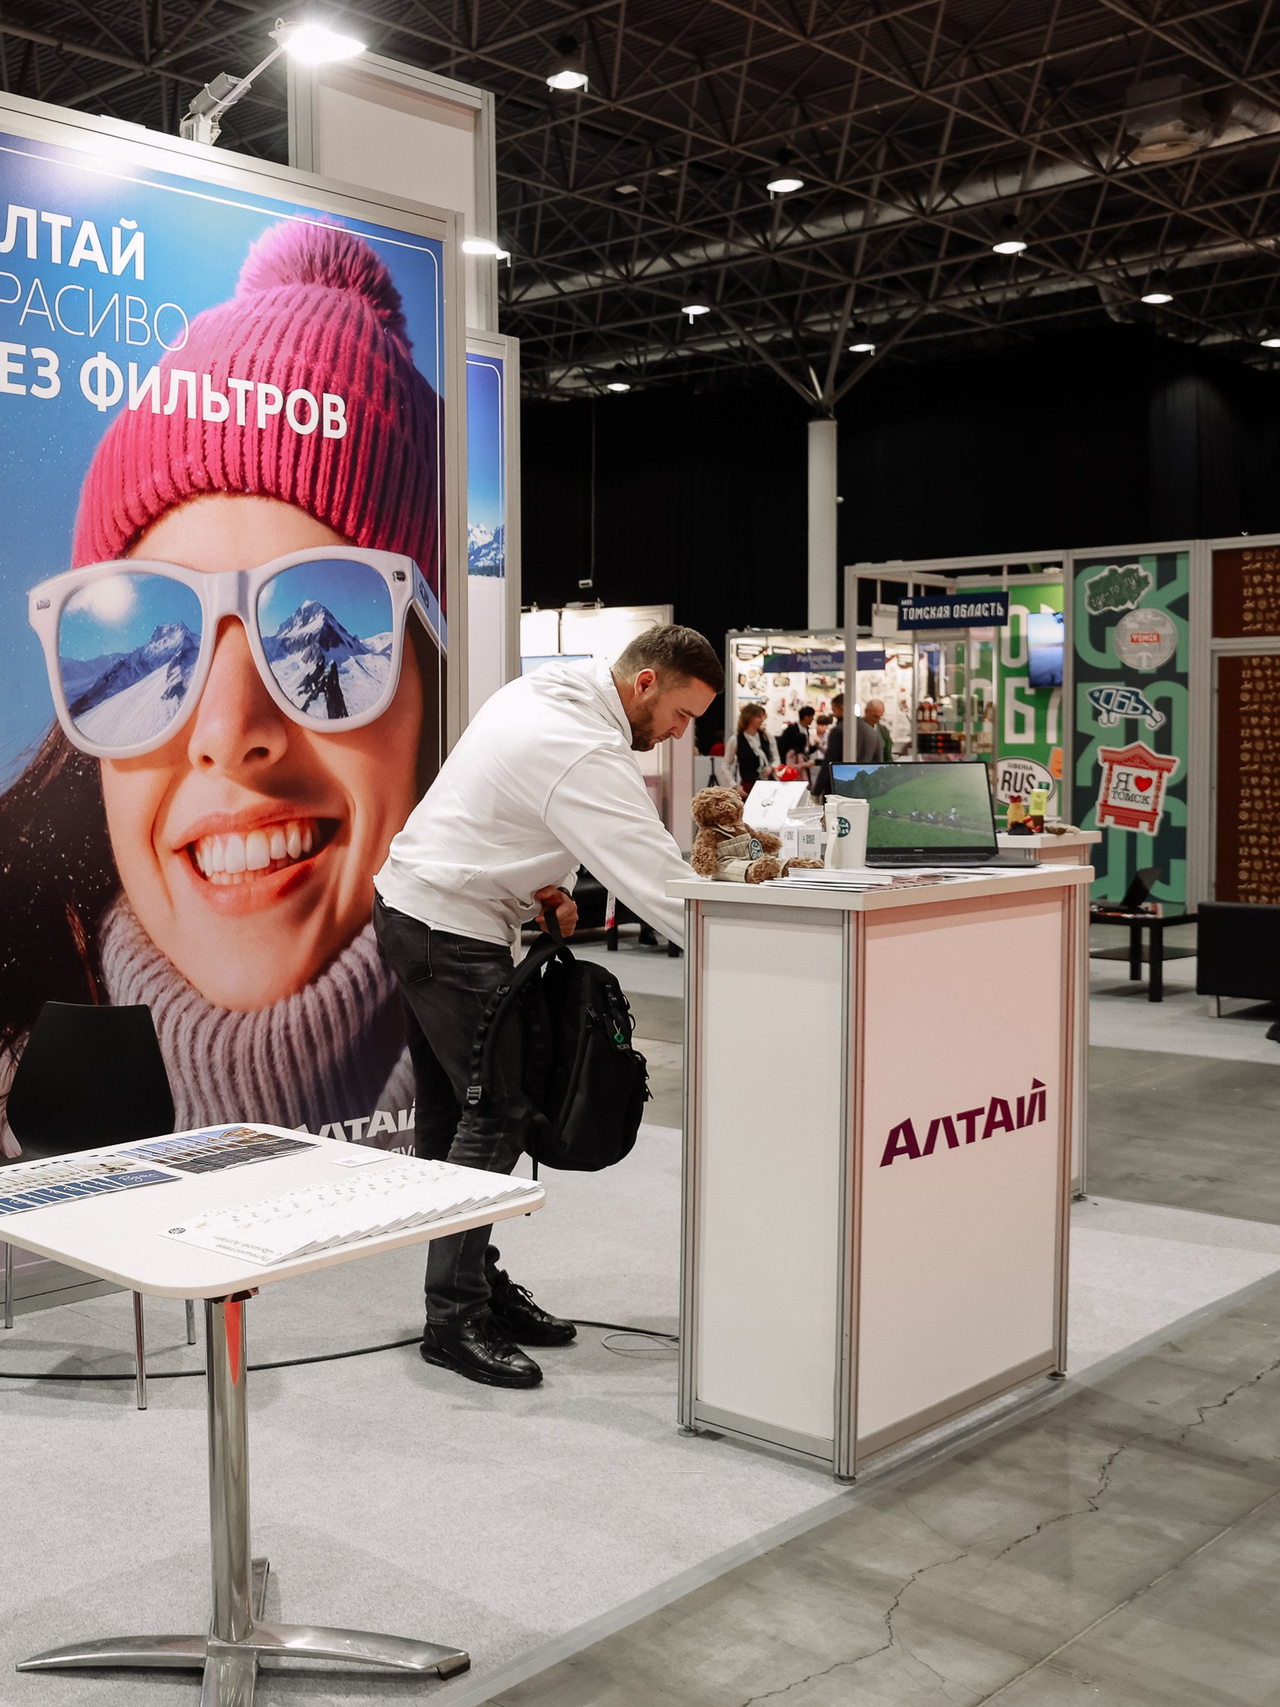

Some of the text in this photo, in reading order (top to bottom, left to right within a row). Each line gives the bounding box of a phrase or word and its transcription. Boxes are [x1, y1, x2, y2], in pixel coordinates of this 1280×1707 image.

[79, 351, 349, 440] ФИЛЬТРОВ
[902, 602, 1004, 620] ТОМСКАЯ ОБЛАСТЬ
[809, 661, 845, 671] Technolog
[1100, 688, 1143, 715] ОБЬ
[1001, 770, 1036, 794] RUS
[1113, 772, 1132, 792] Я
[1111, 790, 1150, 805] ТОМСК
[293, 1097, 416, 1142] ЛТАЙ
[879, 1077, 1046, 1168] АЛТАЙ
